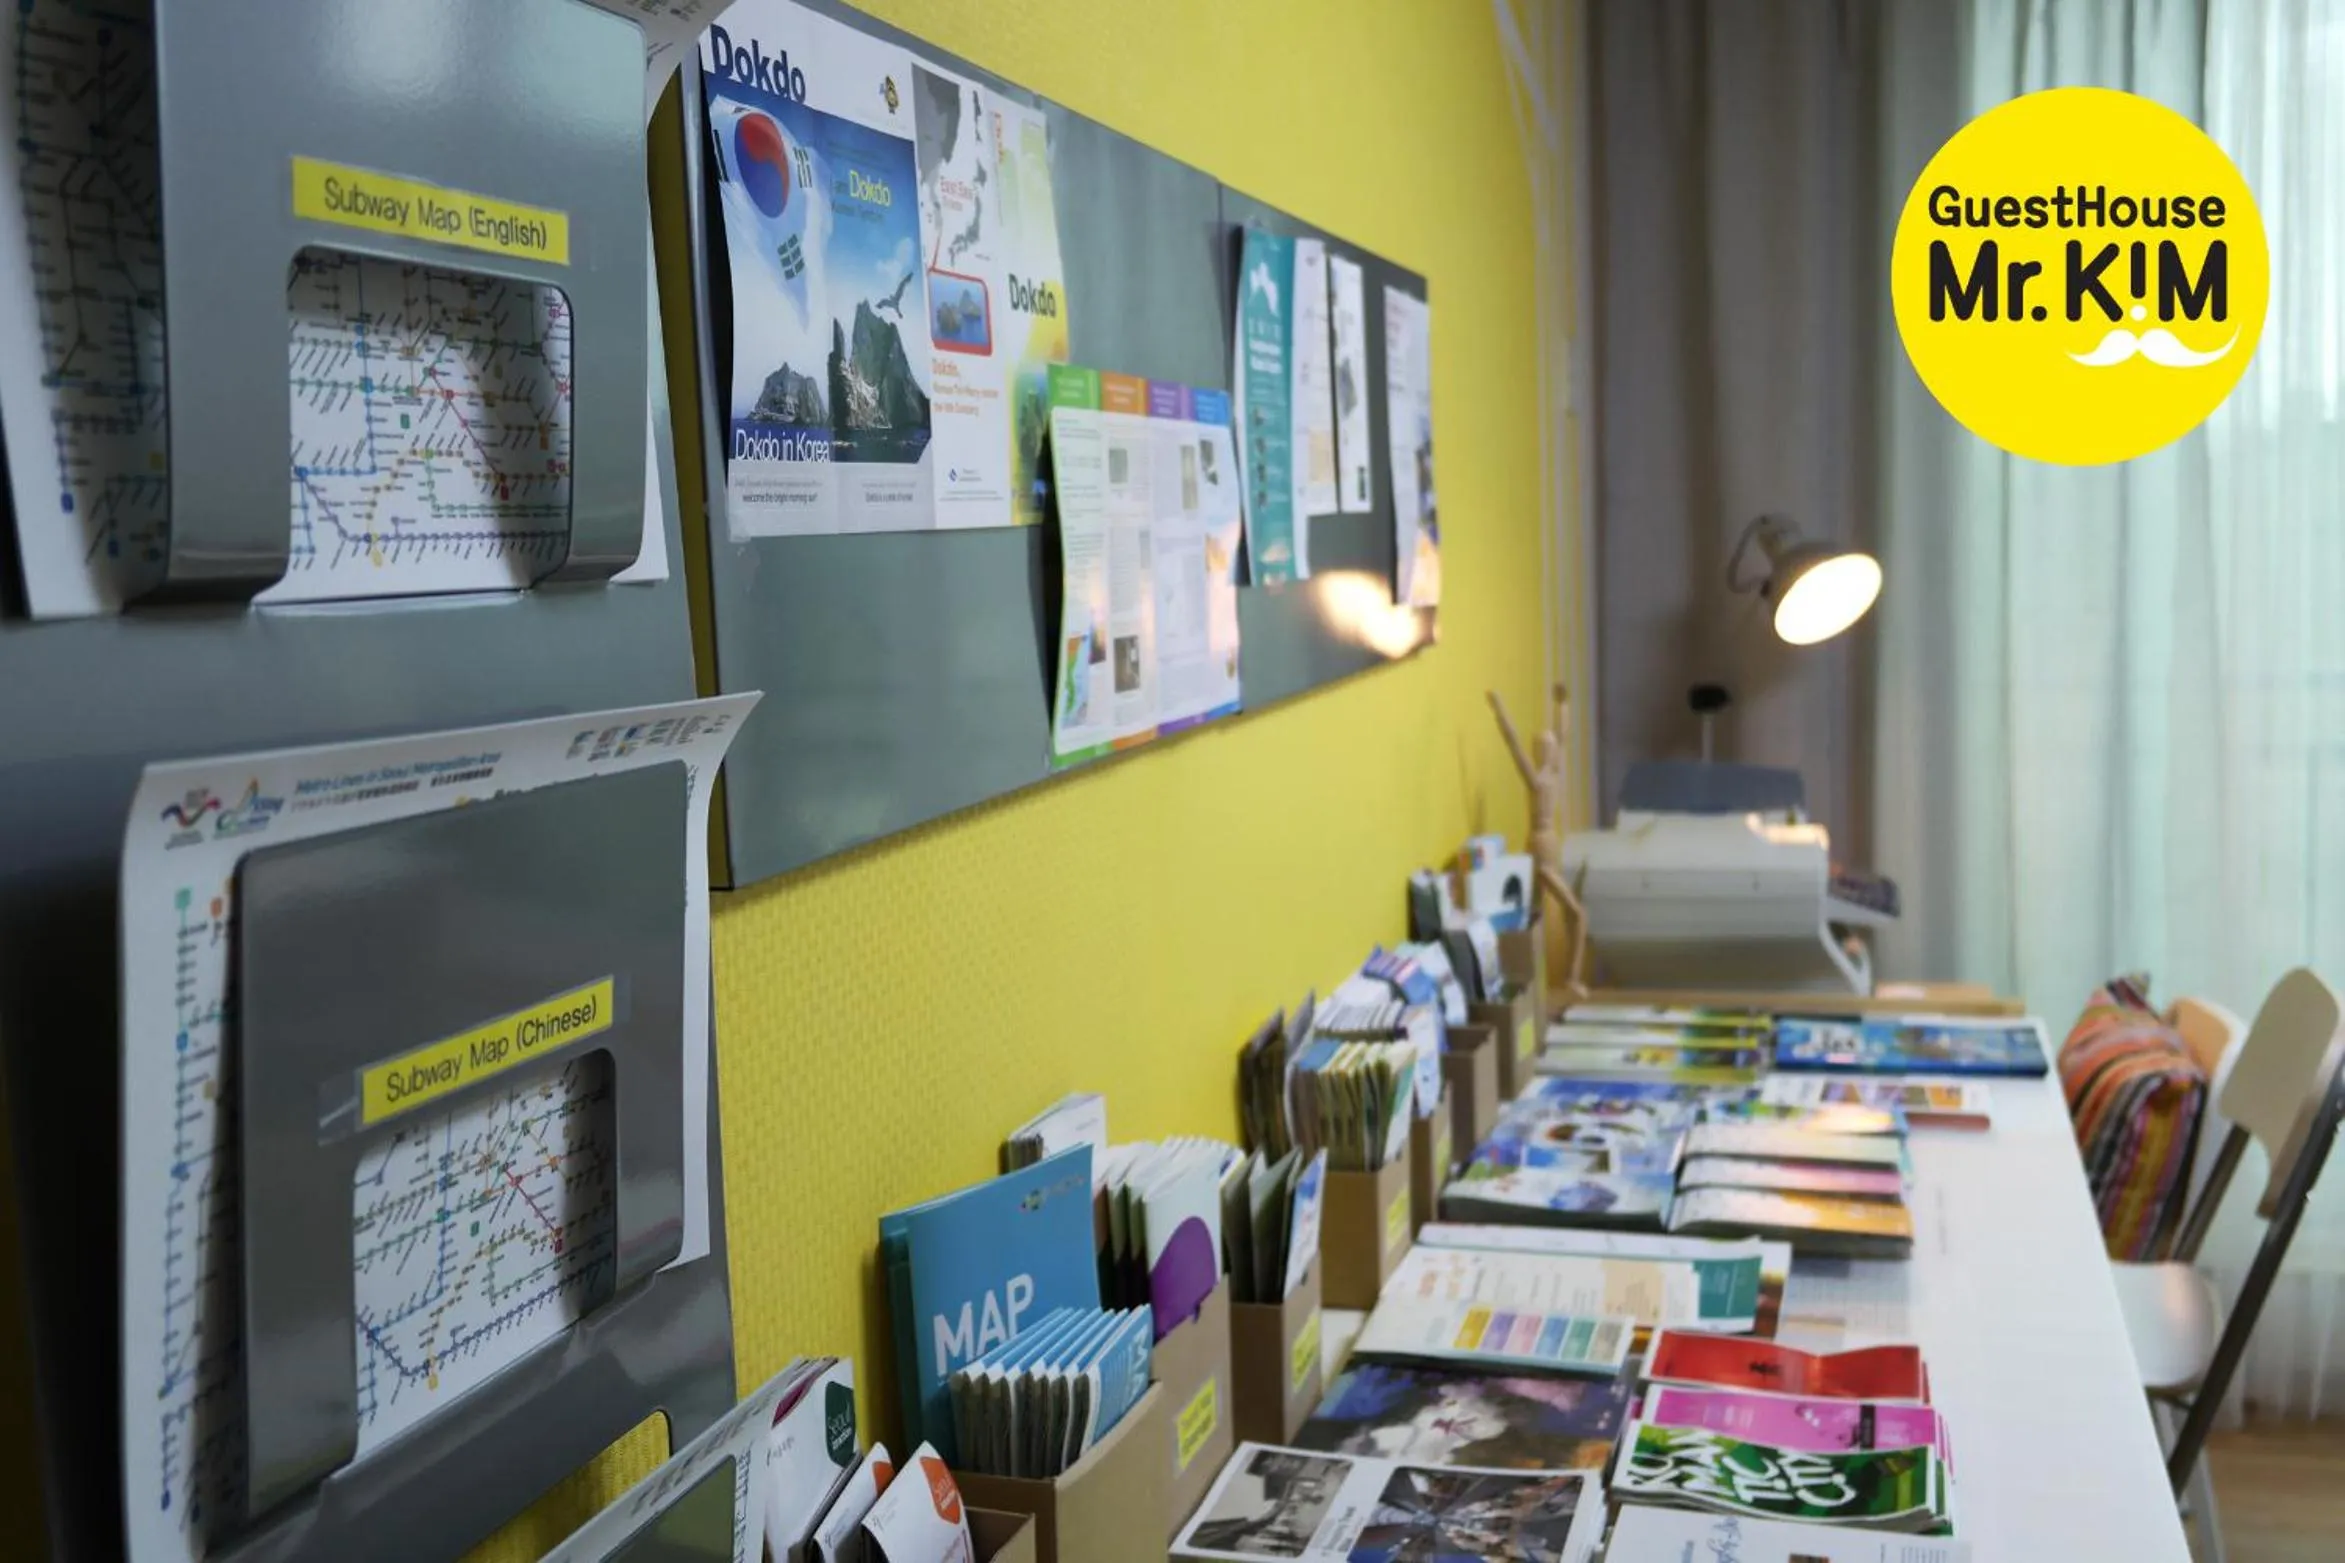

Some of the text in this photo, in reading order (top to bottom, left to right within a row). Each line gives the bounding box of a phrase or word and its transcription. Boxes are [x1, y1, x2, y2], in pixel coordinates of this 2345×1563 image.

[711, 24, 806, 104] Dokdo
[324, 176, 410, 227] Subway
[418, 197, 461, 235] Map
[469, 206, 547, 250] (English)
[850, 169, 890, 207] Dokdo
[1009, 273, 1056, 318] Dokdo
[735, 429, 830, 462] Dokdo in Korea
[387, 995, 597, 1102] Subway Map (Chinese)
[933, 1272, 1034, 1378] MAP
